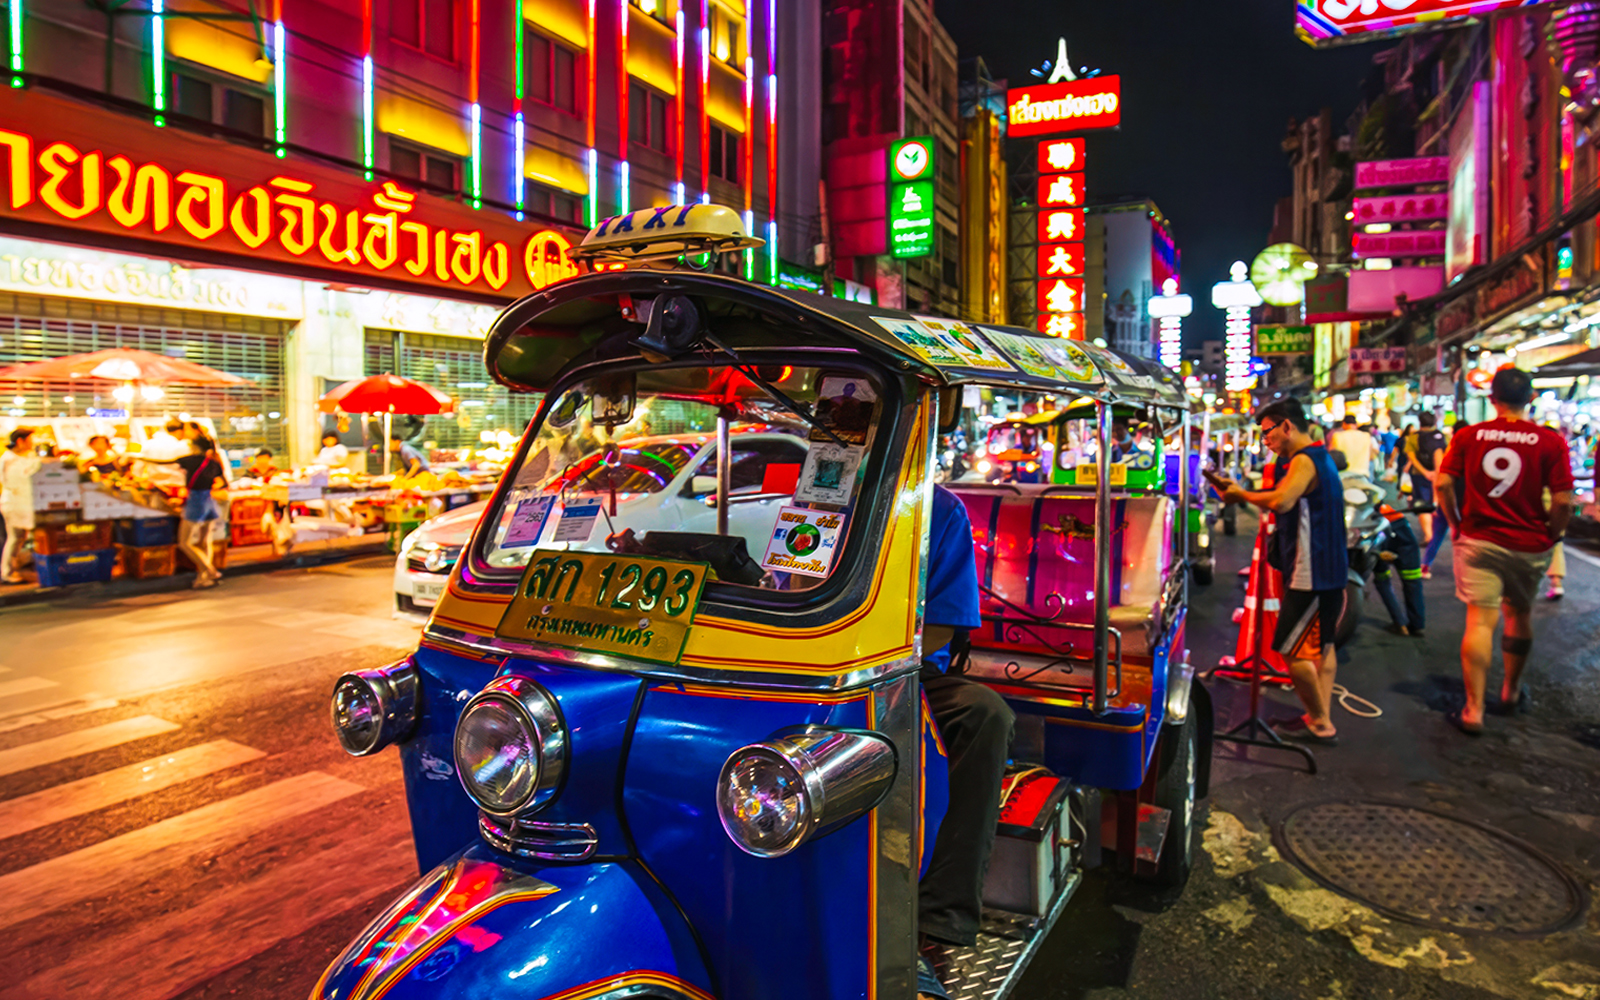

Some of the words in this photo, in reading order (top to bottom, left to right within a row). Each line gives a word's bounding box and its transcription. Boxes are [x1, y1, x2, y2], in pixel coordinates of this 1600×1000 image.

[596, 201, 698, 237] TAXI
[1476, 429, 1539, 445] FIRMINO
[1482, 446, 1522, 498] 9
[524, 555, 584, 603] สก
[594, 561, 695, 617] 1293
[524, 614, 655, 647] กรุงเทพมหานคร
